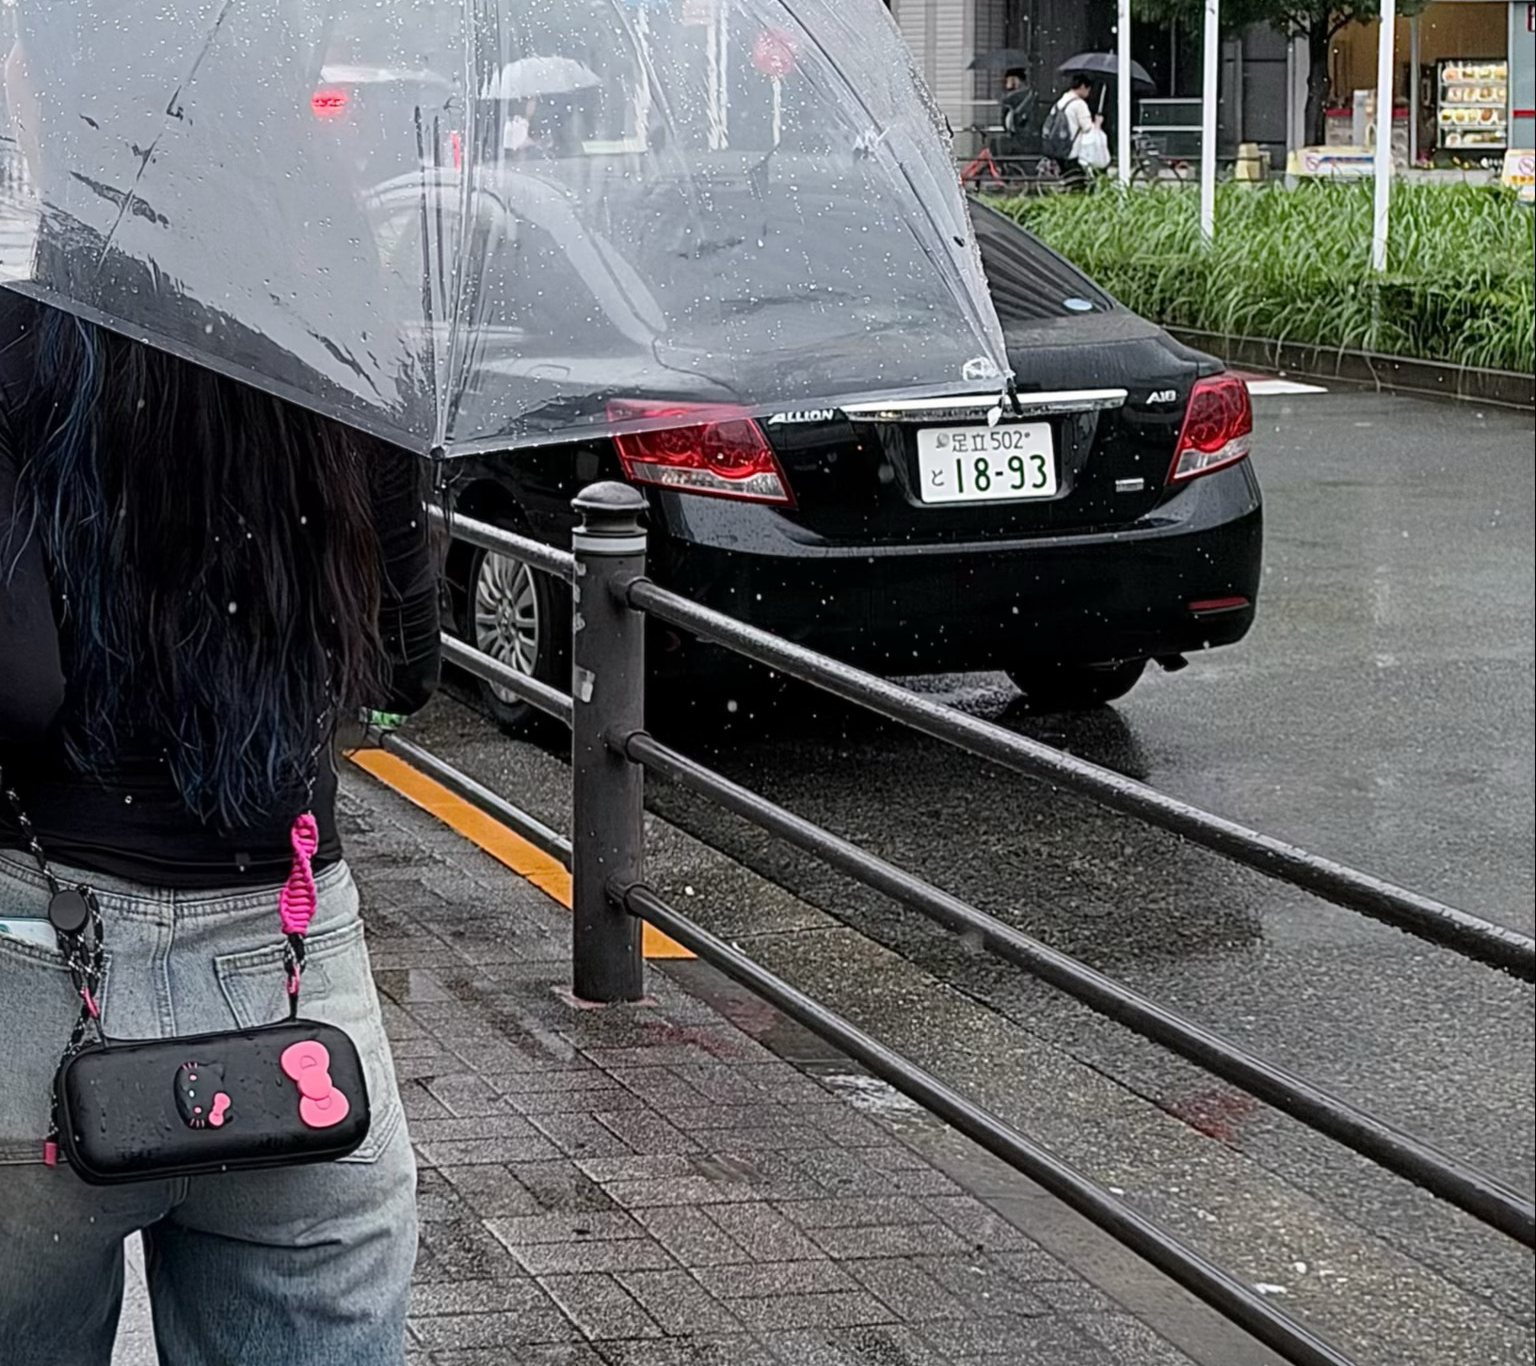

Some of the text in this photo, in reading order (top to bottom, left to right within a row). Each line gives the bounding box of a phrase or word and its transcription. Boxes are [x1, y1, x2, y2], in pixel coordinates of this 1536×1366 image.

[767, 408, 834, 426] ALLION
[952, 430, 1024, 453] 足立 502
[931, 454, 1047, 494] と 18-93
